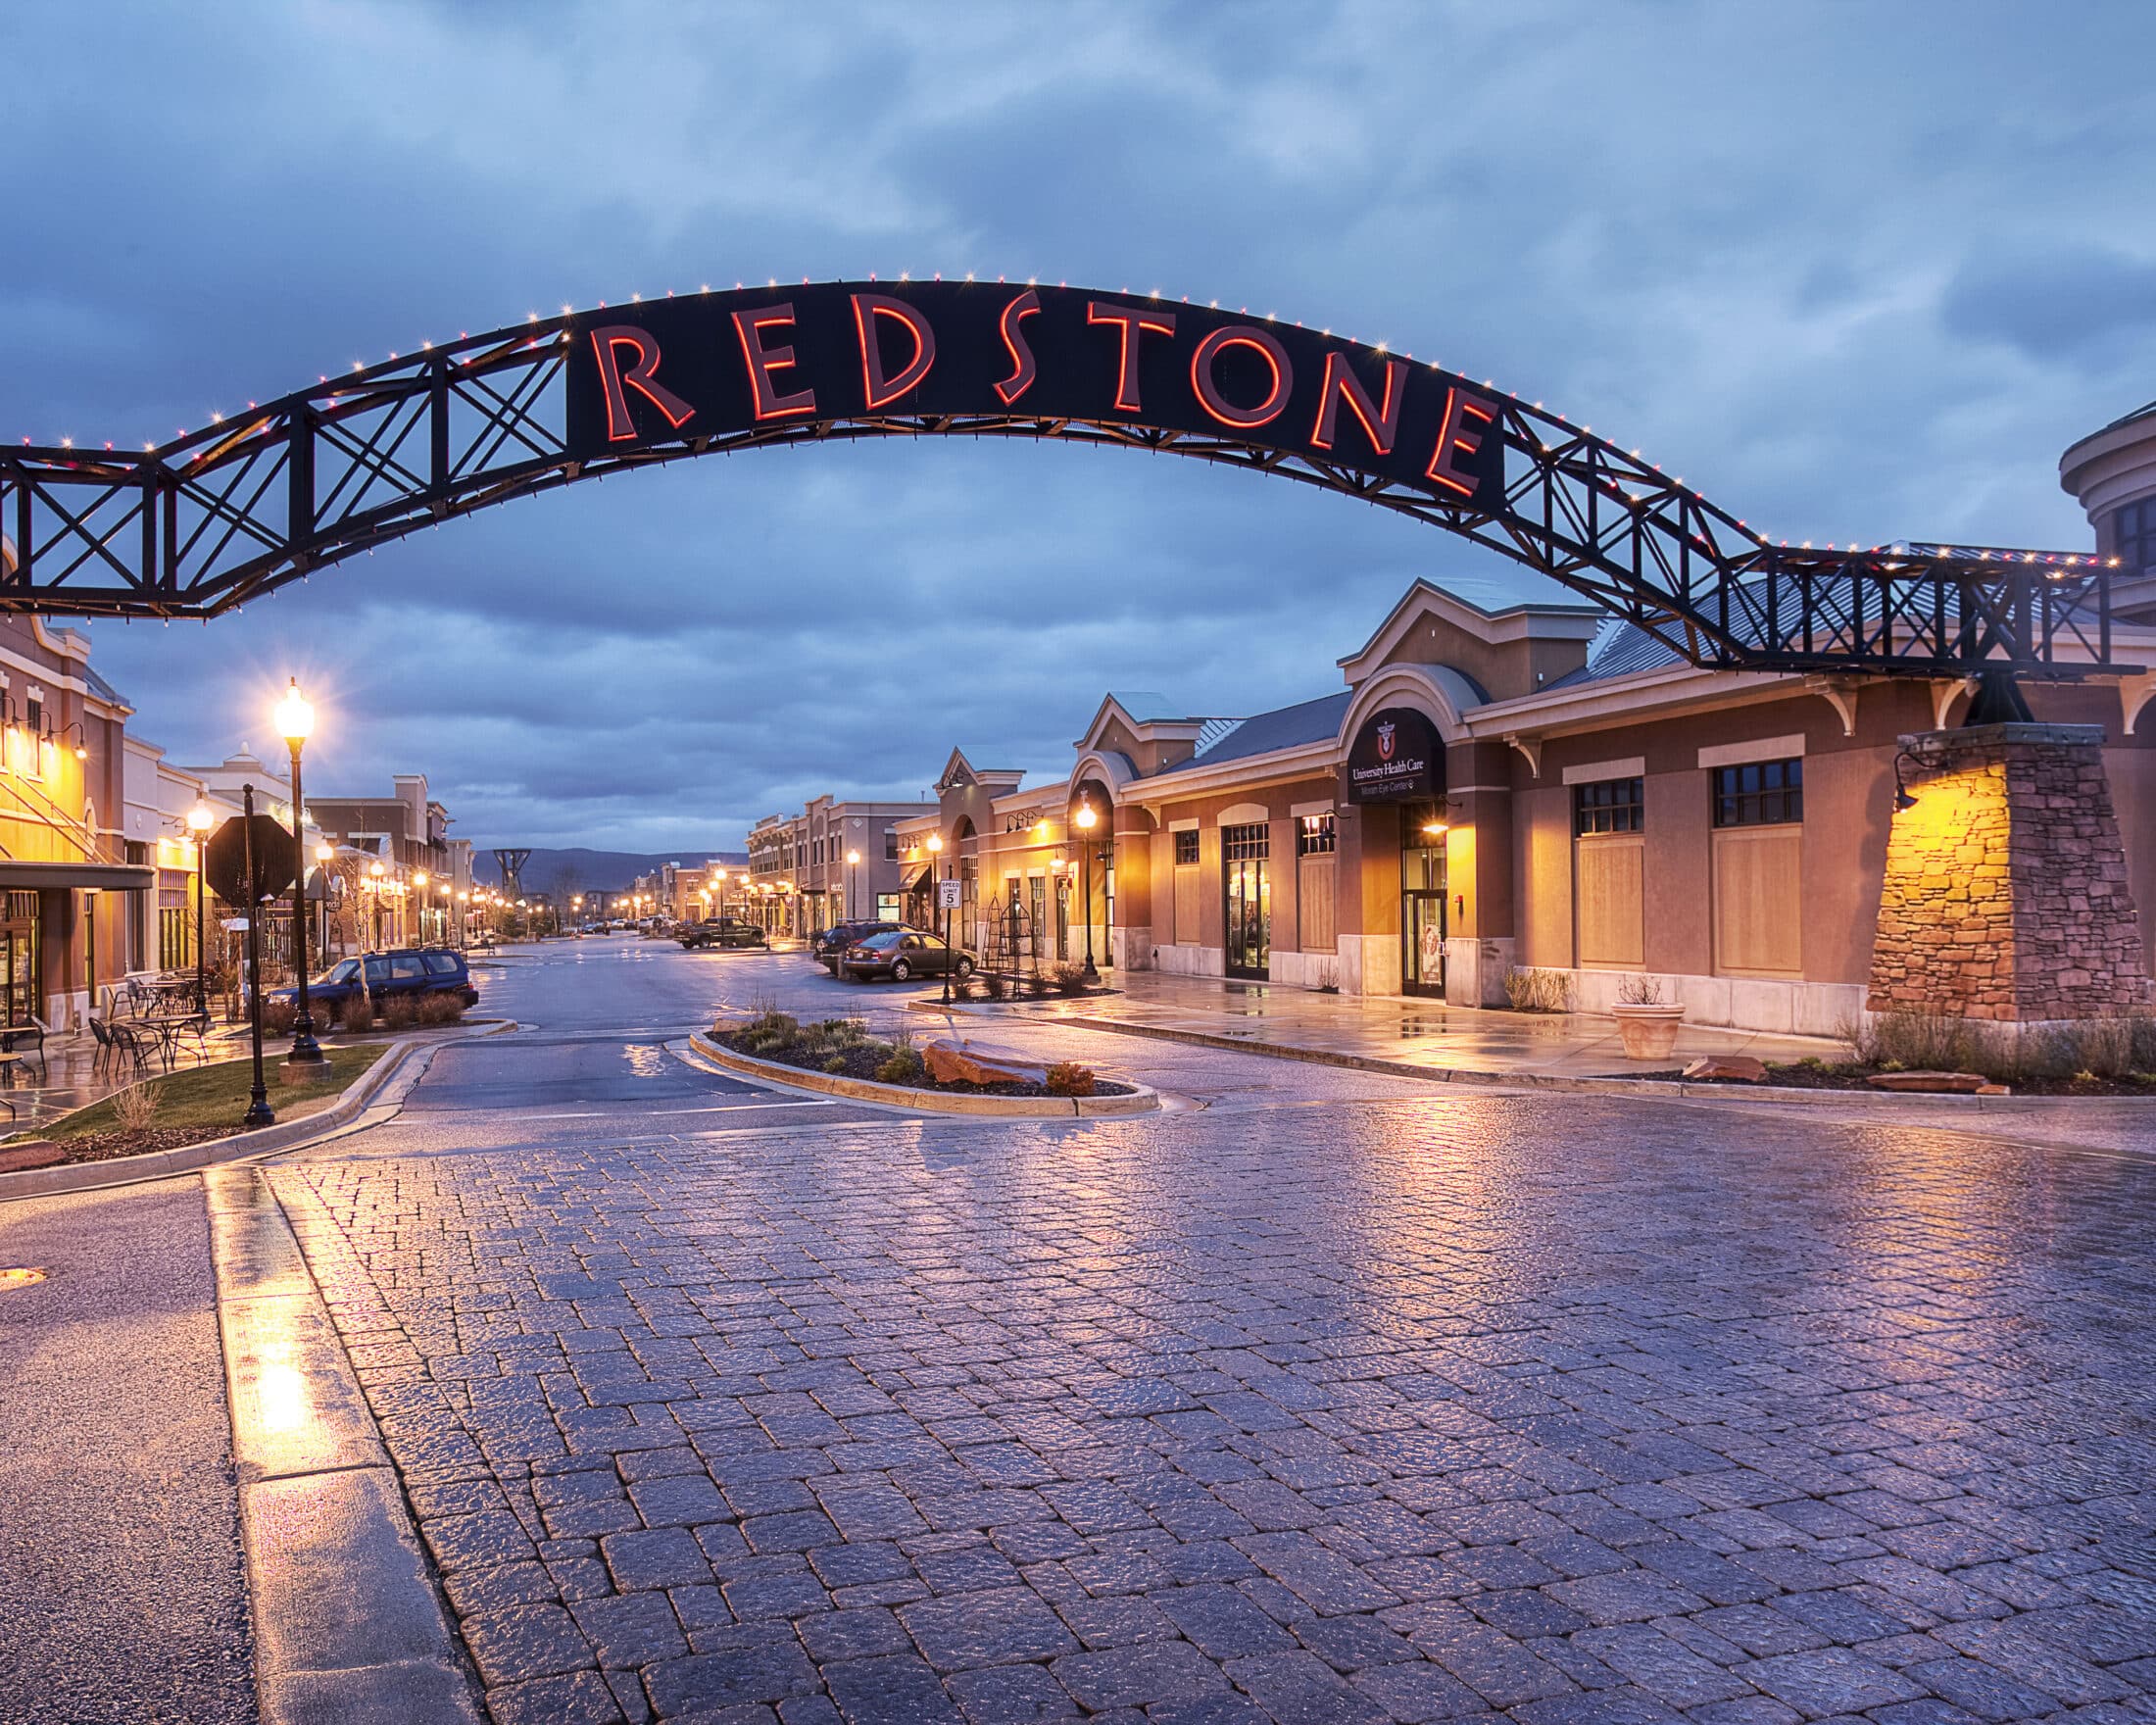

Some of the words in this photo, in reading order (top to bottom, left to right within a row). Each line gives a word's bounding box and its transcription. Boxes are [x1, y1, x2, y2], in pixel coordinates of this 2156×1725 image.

[590, 289, 1499, 497] REDSTONE
[1352, 767, 1384, 779] University
[1384, 760, 1406, 775] Health
[1406, 758, 1424, 771] Care
[1378, 783, 1390, 794] Eye
[1389, 781, 1407, 792] Center
[947, 893, 955, 903] 5
